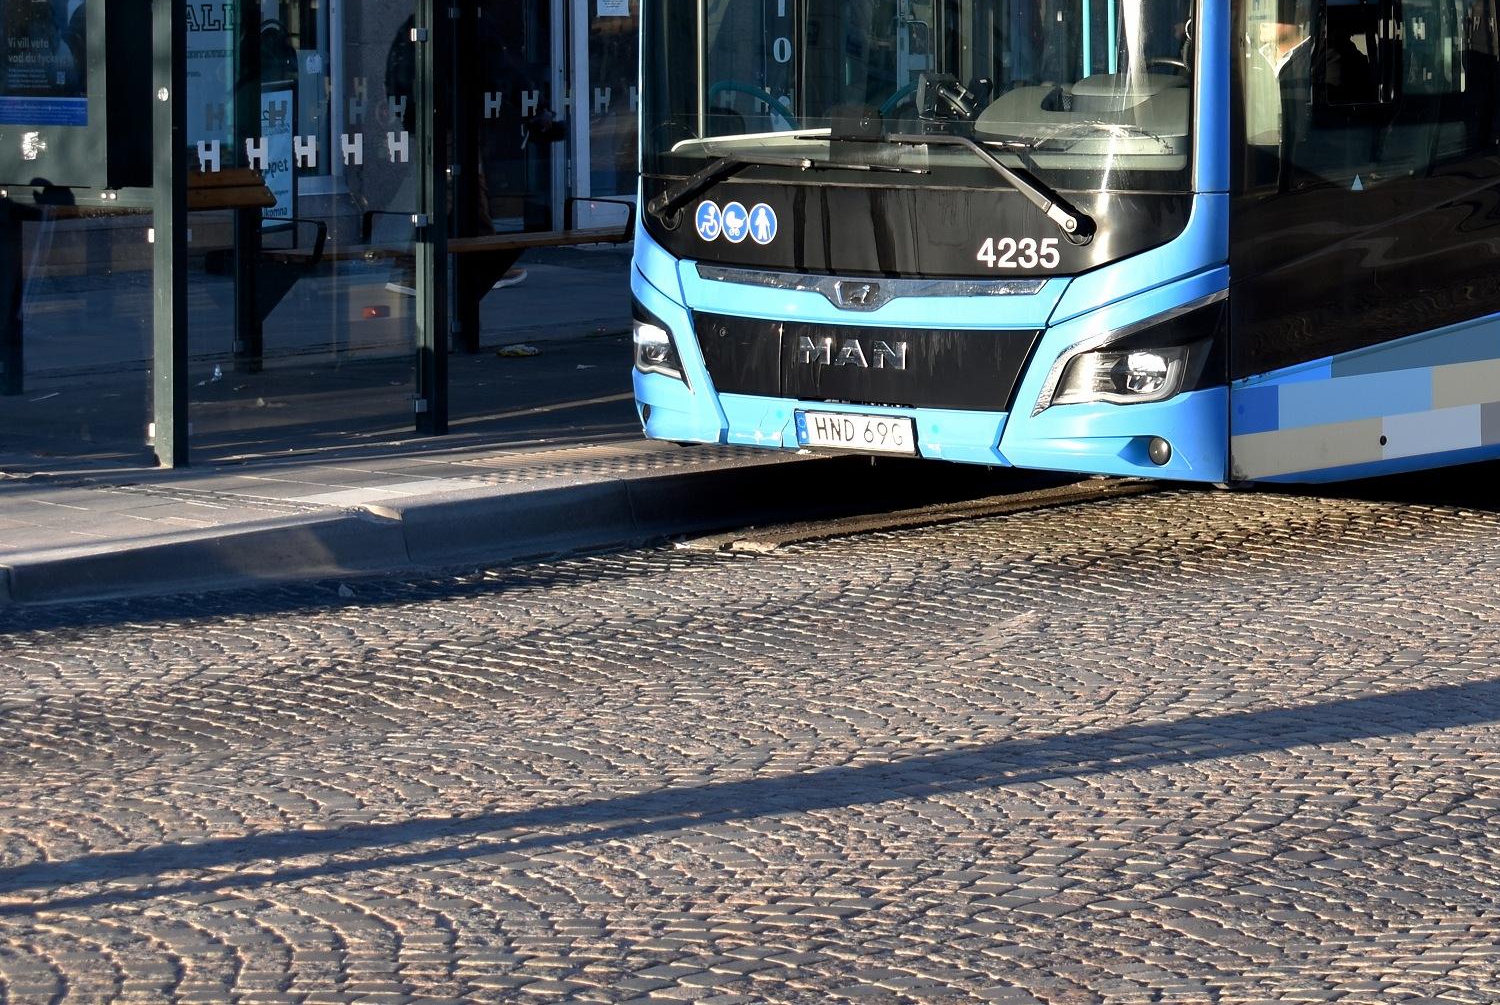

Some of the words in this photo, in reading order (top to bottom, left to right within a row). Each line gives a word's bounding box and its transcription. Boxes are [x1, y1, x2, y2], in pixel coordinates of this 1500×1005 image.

[976, 237, 1060, 269] 4235
[799, 336, 906, 370] MAN
[814, 417, 855, 442] HND
